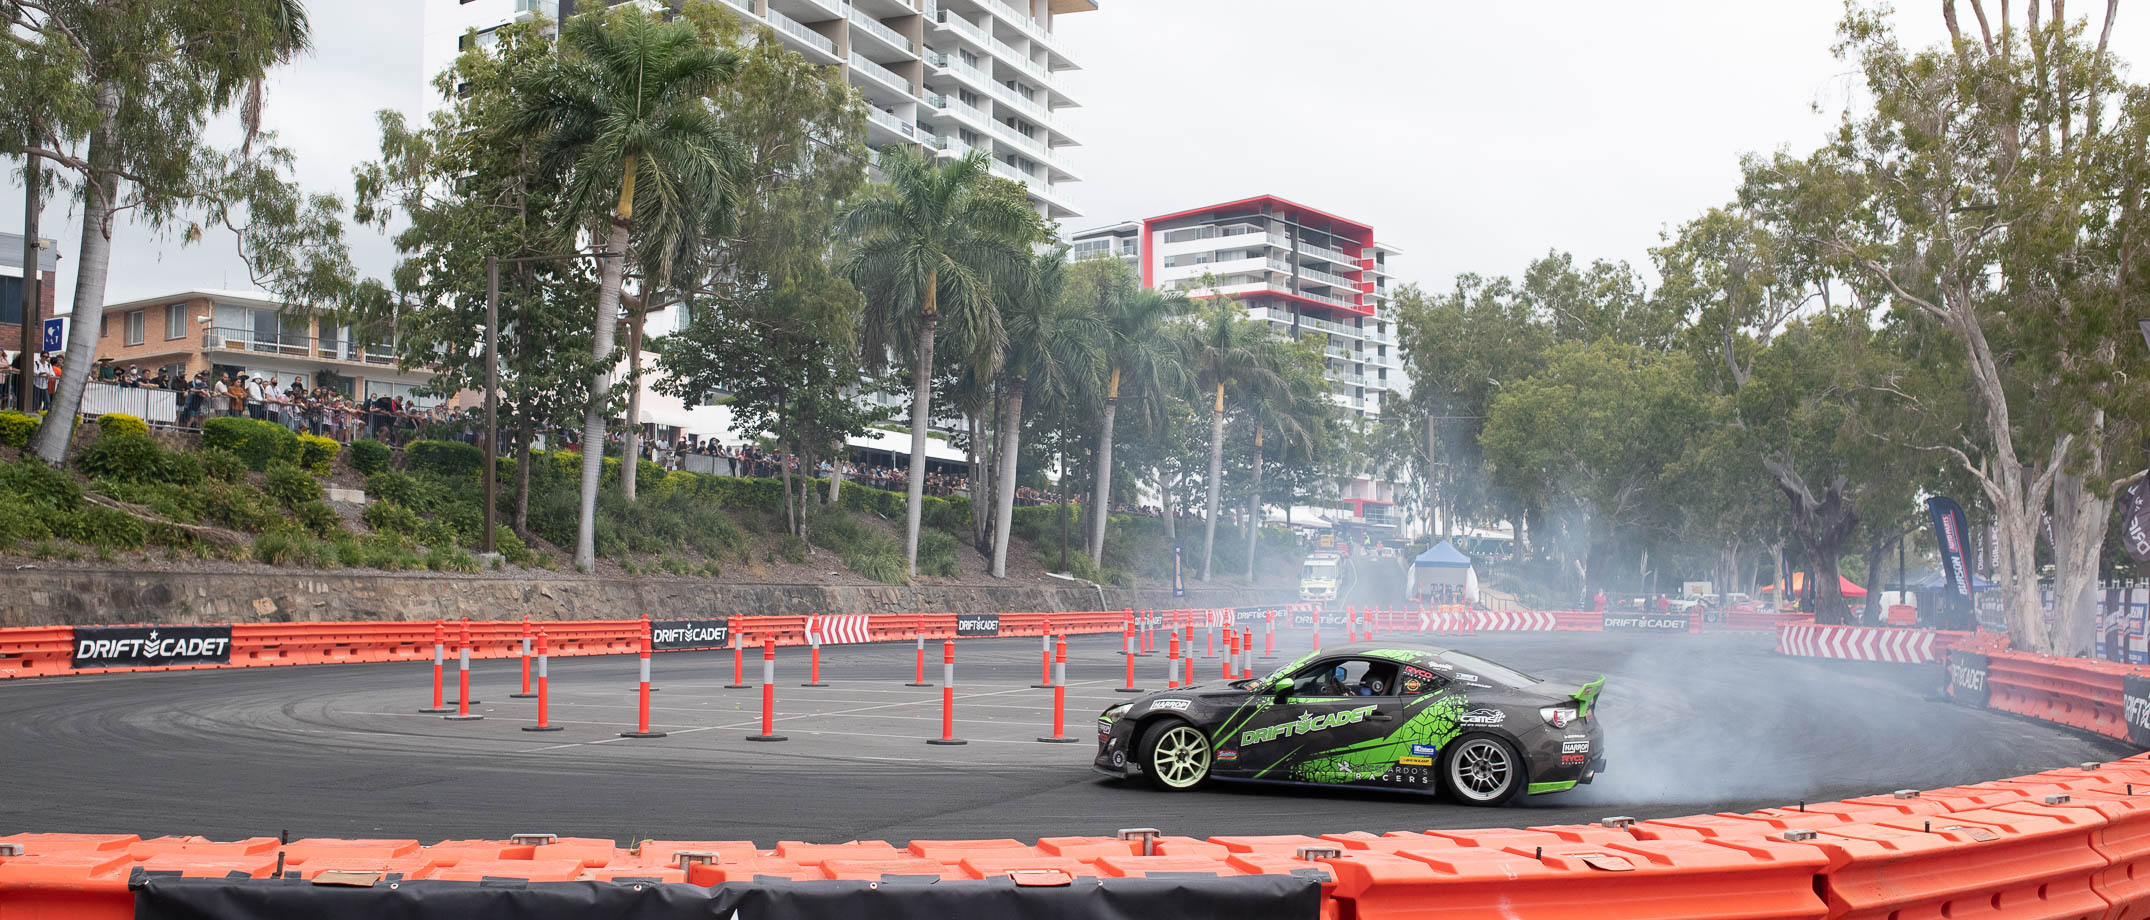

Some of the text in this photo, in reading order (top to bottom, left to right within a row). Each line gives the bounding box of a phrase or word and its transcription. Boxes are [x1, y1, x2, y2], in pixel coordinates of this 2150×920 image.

[1237, 611, 1257, 620] DRIFT
[1295, 615, 1327, 624] DRIT
[958, 620, 999, 631] DRIFT CADET
[1604, 618, 1687, 629] DRIFT CADET
[653, 627, 728, 643] DRIFT CADET
[77, 638, 229, 659] DRIFT CADET
[1404, 665, 1433, 679] RYCO
[1963, 667, 1986, 692] CADET
[1241, 704, 1378, 747] DRIFT CADET
[1355, 772, 1428, 784] RACERS
